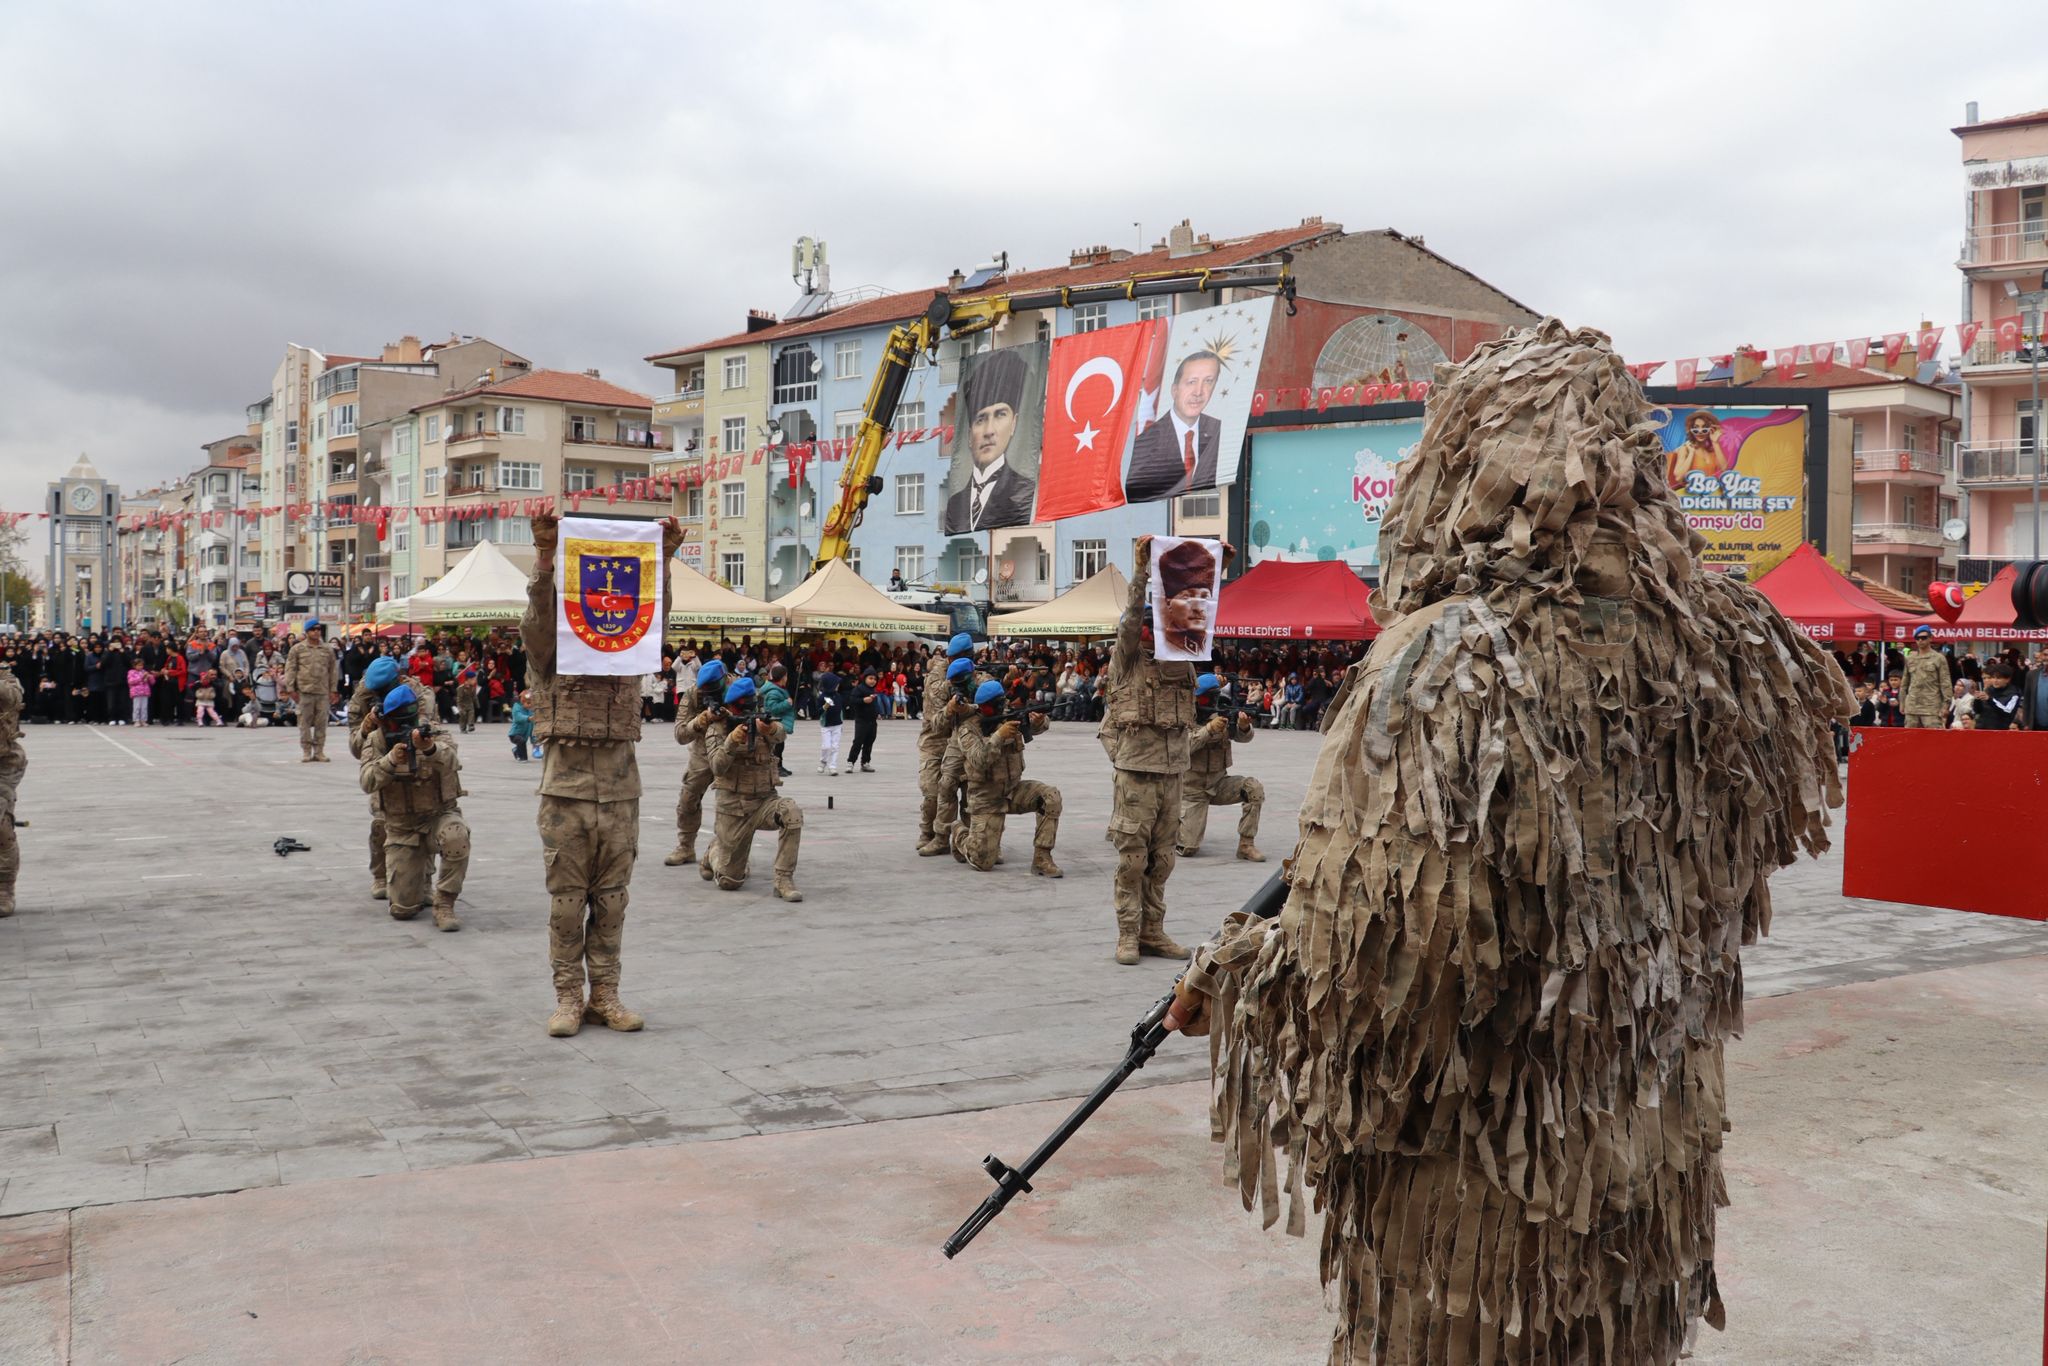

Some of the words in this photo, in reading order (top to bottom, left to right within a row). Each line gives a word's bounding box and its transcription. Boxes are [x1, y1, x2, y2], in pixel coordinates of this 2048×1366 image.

[1686, 469, 1720, 494] Bu
[1720, 470, 1762, 497] Yaz
[1730, 496, 1763, 510] HER
[1765, 496, 1796, 512] ŞEY
[1684, 513, 1763, 530] omşu'da
[308, 575, 341, 587] YHM
[462, 610, 511, 619] KARAMAN
[697, 614, 704, 623] İL
[705, 614, 725, 623] ÖZEL
[726, 614, 757, 624] İDARESİ
[571, 613, 649, 649] JANDARMA
[831, 621, 871, 630] KARAMAN
[872, 621, 879, 630] İL
[879, 622, 897, 631] ÖZEL
[898, 623, 926, 632] İDARESİ
[1019, 625, 1052, 634] KARAMAN
[1238, 625, 1292, 637] BELEDİYESİ
